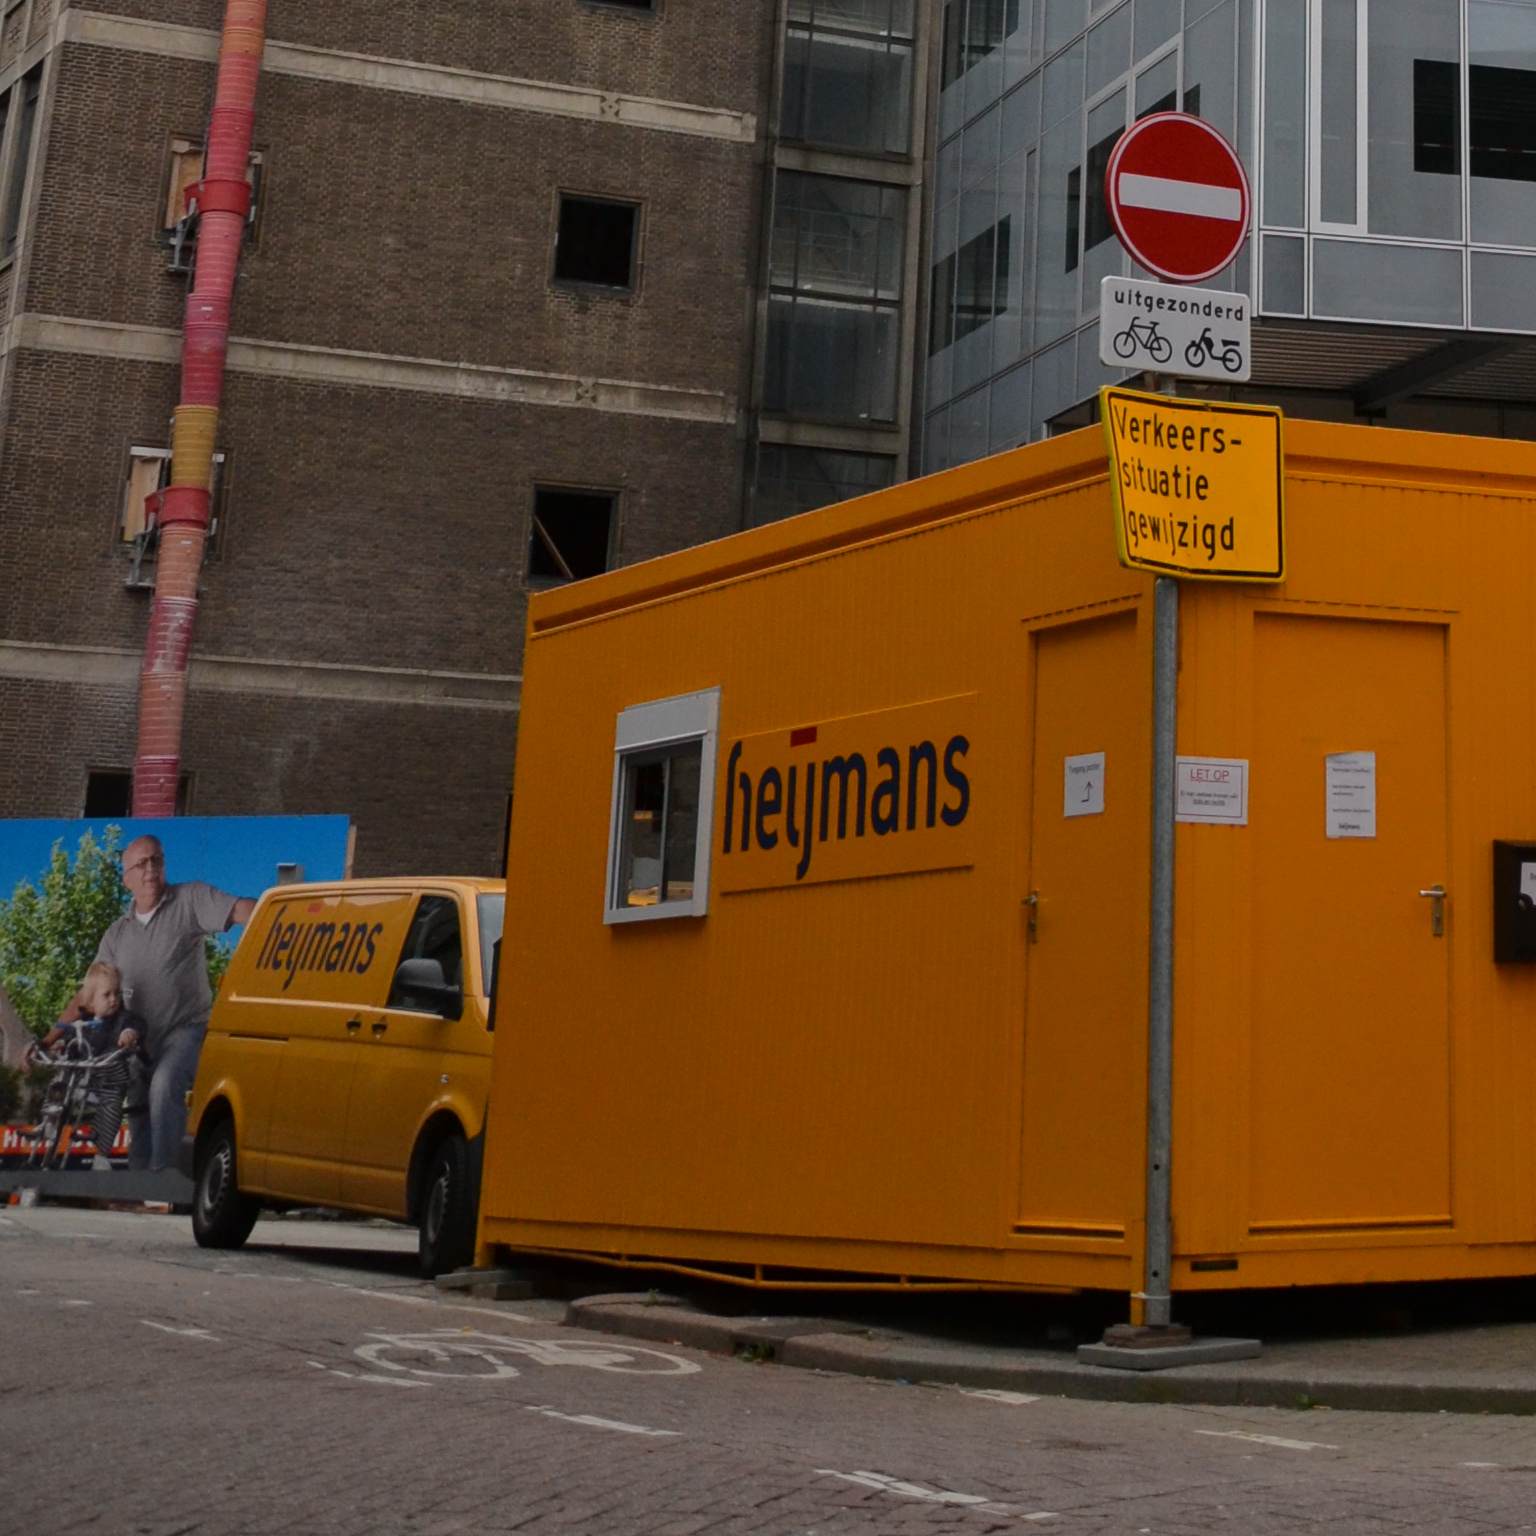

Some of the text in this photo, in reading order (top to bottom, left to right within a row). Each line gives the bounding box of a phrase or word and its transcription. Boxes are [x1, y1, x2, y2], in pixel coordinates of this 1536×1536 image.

[1114, 289, 1244, 322] uitgezonderd
[1113, 404, 1243, 454] Verkeers-
[1121, 456, 1209, 501] situatie
[1127, 509, 1235, 562] gewijzigd
[1190, 768, 1230, 782] LET OP
[722, 726, 971, 881] heijmans
[255, 903, 384, 992] heijmans
